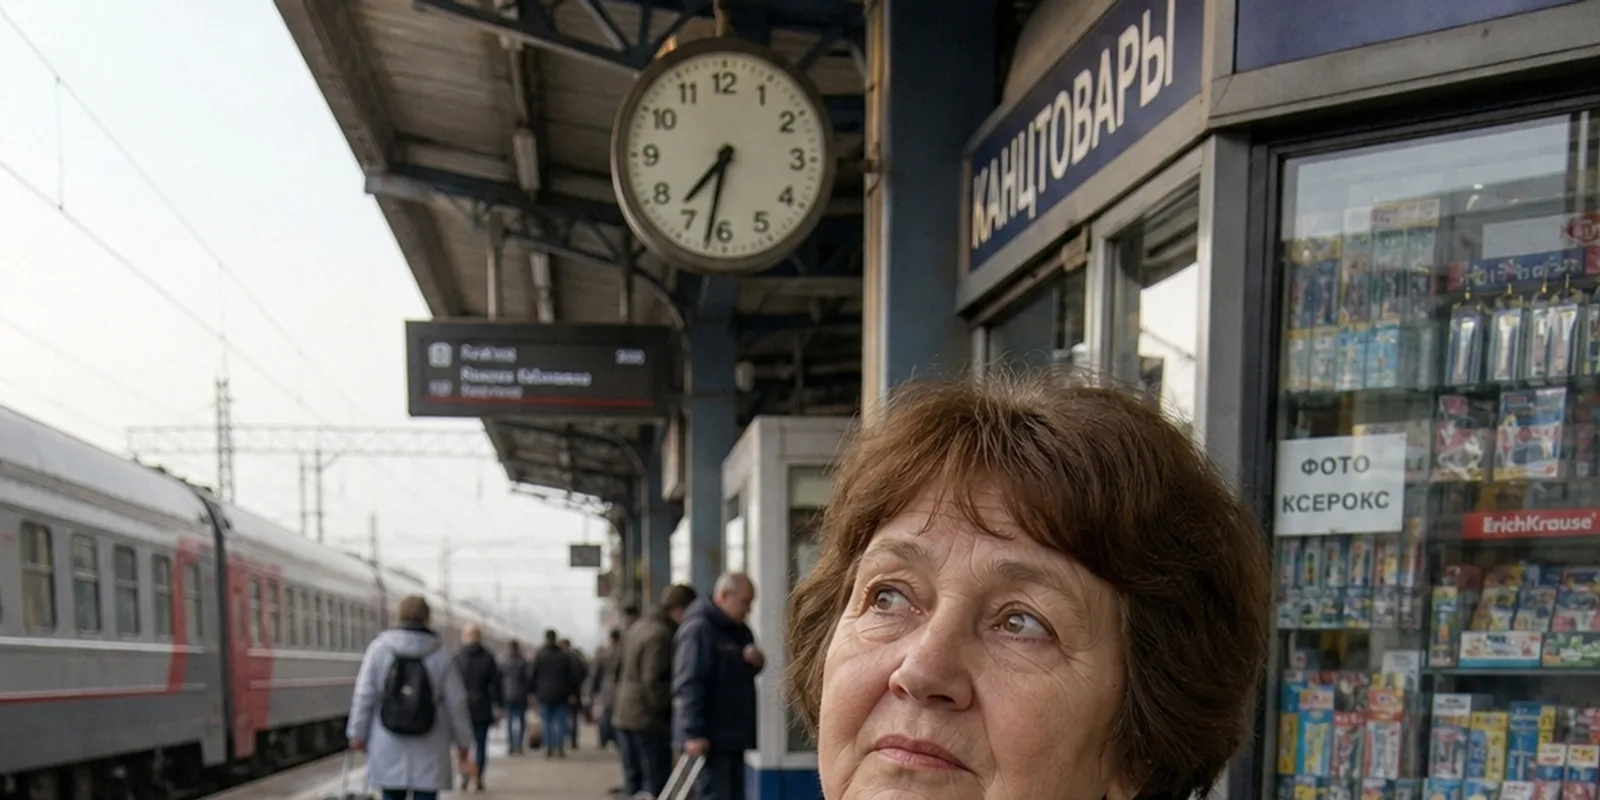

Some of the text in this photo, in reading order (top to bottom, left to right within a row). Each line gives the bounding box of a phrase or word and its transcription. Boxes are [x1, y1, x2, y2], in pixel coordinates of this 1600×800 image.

[677, 82, 698, 105] 11
[711, 71, 737, 95] 12
[756, 84, 767, 107] 1
[651, 107, 678, 131] 10
[778, 110, 796, 133] 2
[971, 0, 1176, 250] КАНЦТОВАРЫ
[641, 143, 660, 167] 9
[789, 148, 806, 171] 3
[652, 182, 671, 205] 8
[777, 185, 795, 208] 4
[680, 208, 698, 231] 7
[752, 210, 770, 233] 5
[715, 220, 734, 243] 6
[1300, 455, 1371, 477] ФОТО
[1281, 490, 1391, 514] КСЕРОКС
[1482, 514, 1593, 533] ErichKrause
